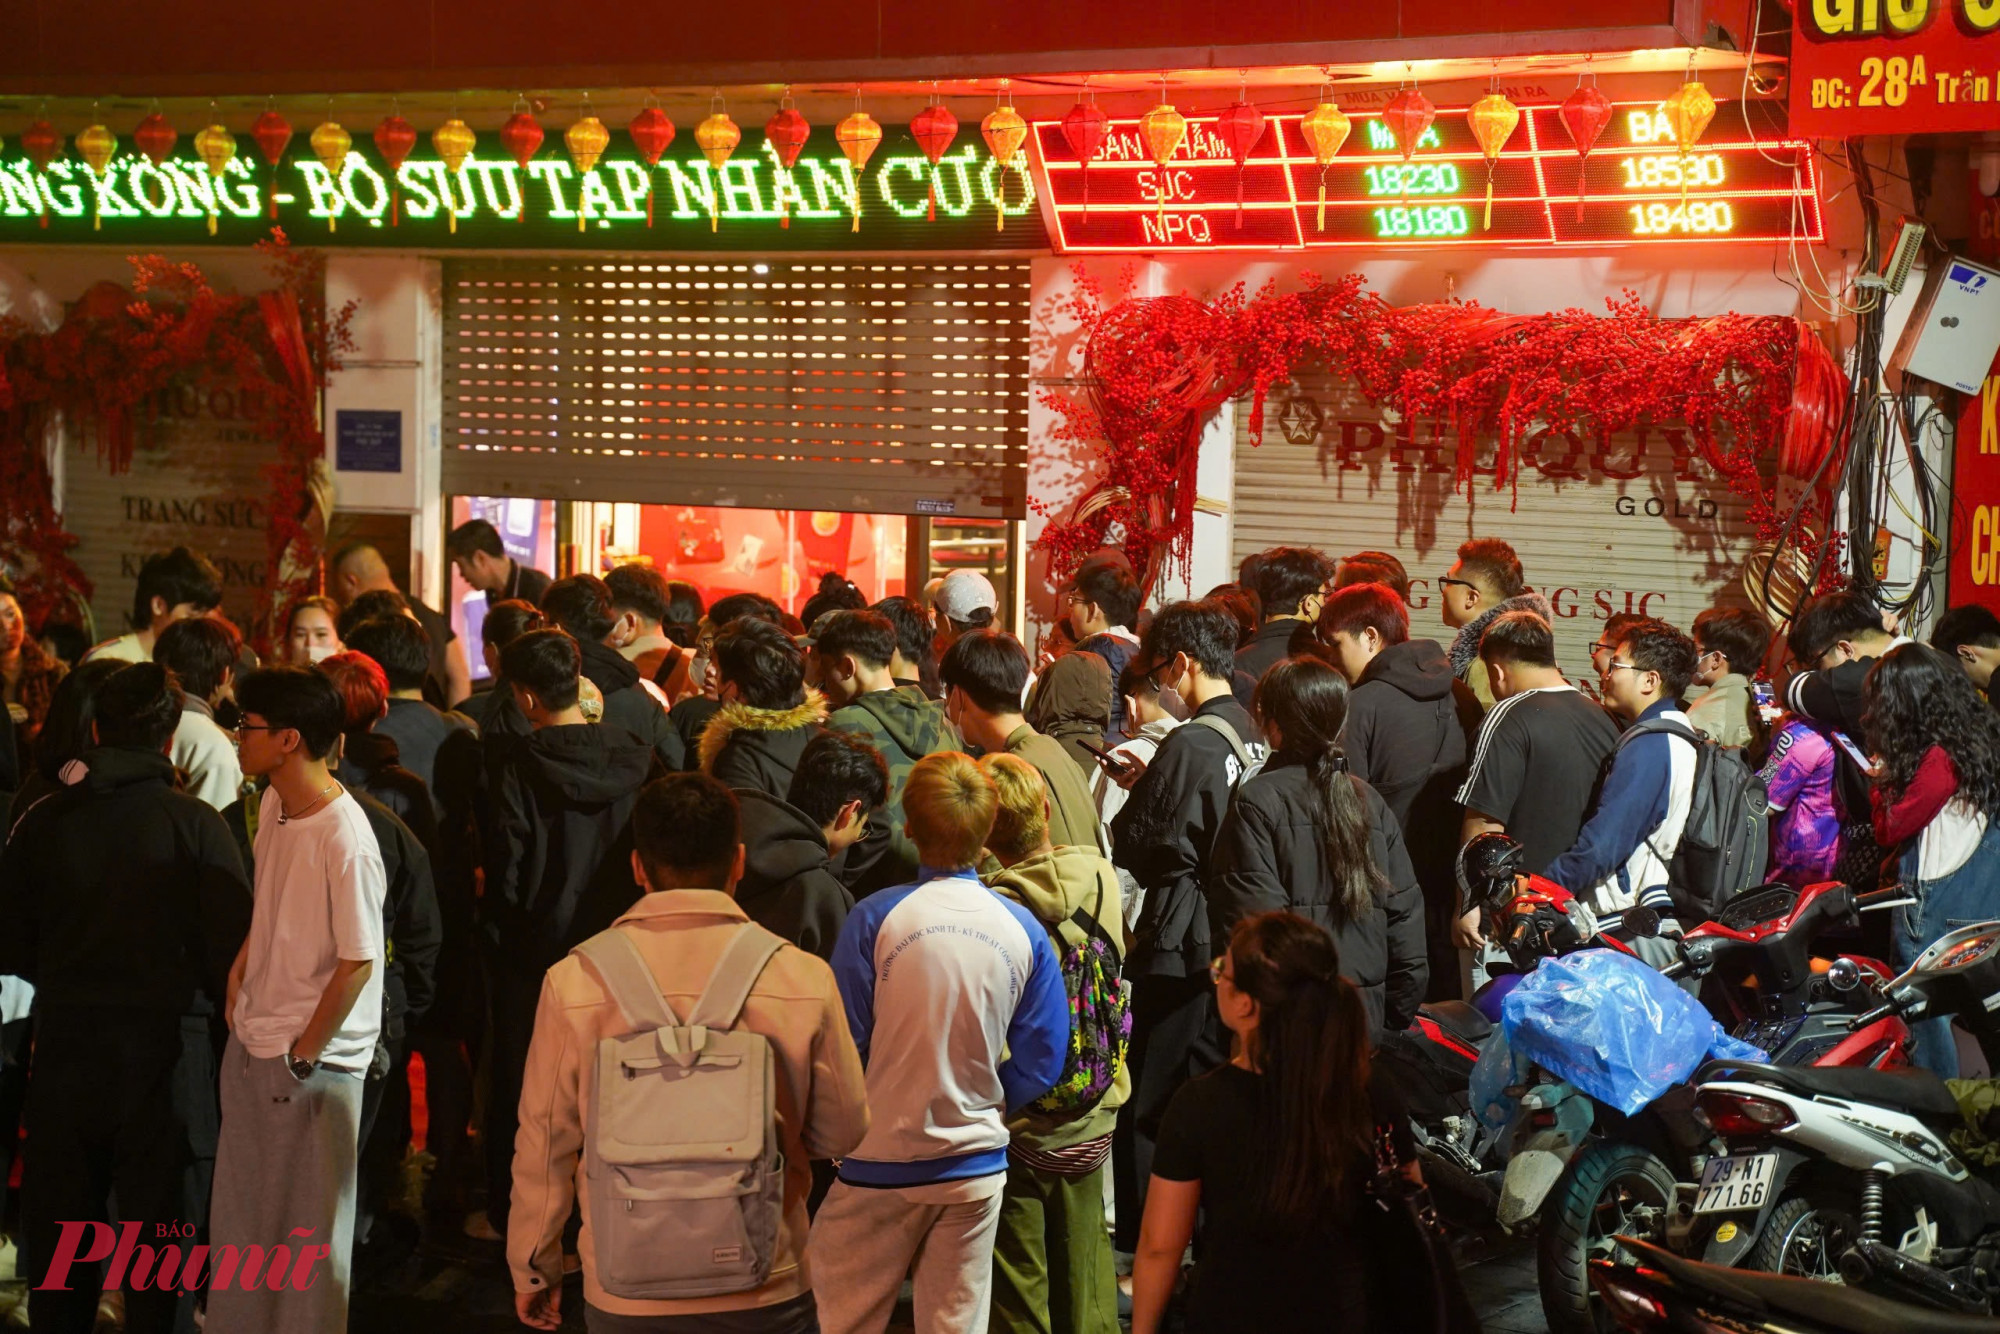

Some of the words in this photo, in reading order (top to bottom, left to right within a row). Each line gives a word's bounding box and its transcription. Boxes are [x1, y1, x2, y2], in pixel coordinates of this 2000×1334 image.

[1811, 78, 1851, 109] ĐC:
[1368, 119, 1440, 150] MA
[1137, 170, 1196, 200] SJC
[1364, 163, 1460, 195] 18230
[1621, 154, 1726, 188] 18530
[1141, 213, 1212, 243] NPQ
[1374, 206, 1469, 237] 18180
[1629, 201, 1734, 234] 18480
[121, 495, 207, 526] TRANG
[1615, 496, 1719, 519] GOLD
[926, 924, 946, 935] KINH
[1698, 1182, 1765, 1210] 771.66
